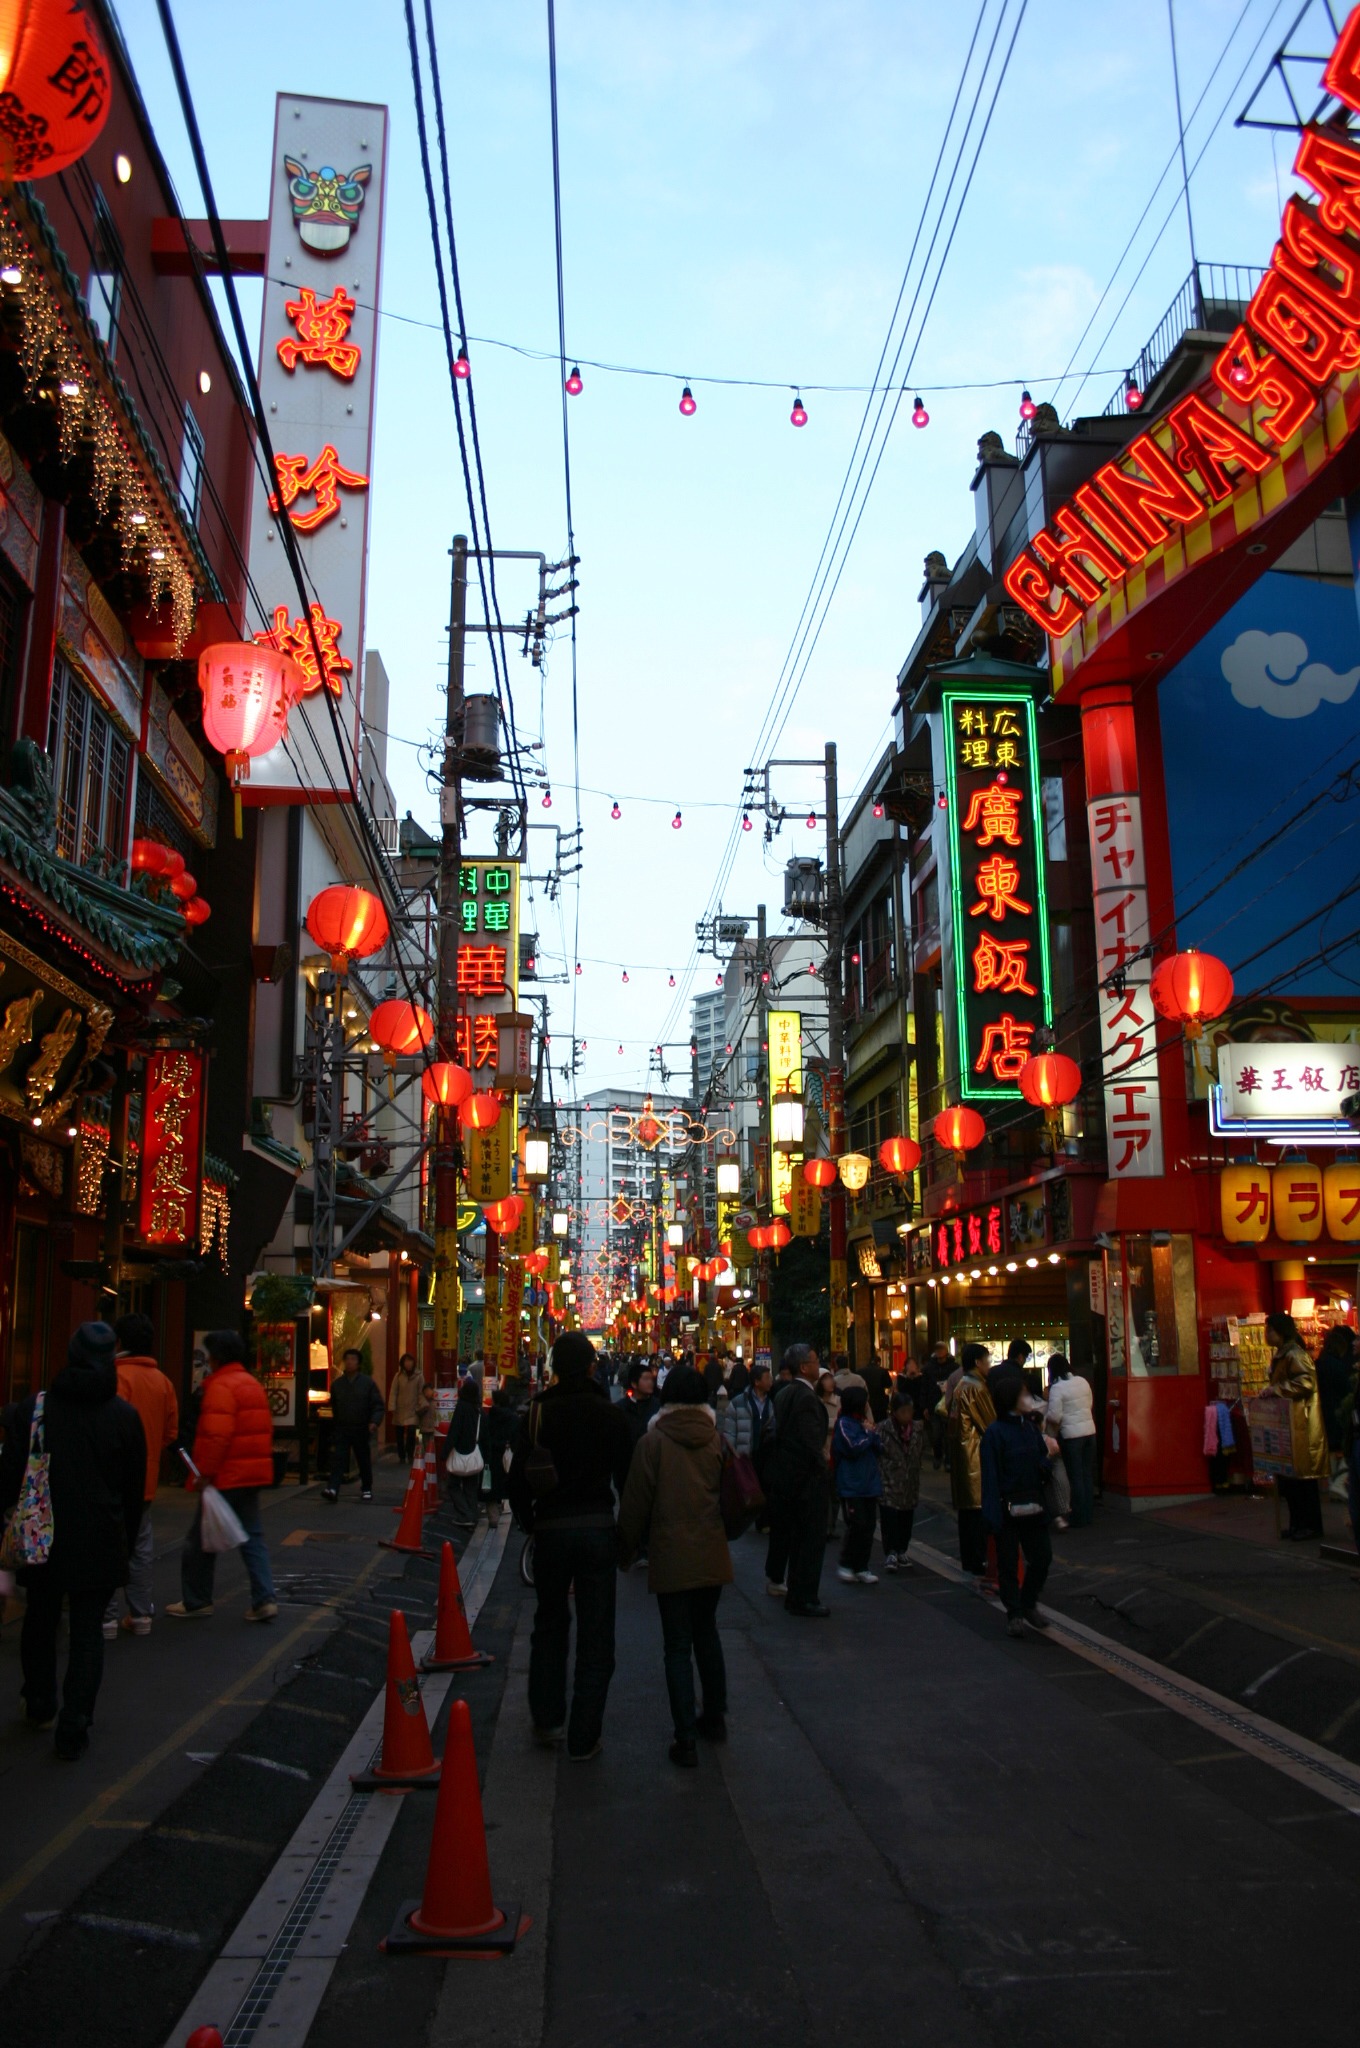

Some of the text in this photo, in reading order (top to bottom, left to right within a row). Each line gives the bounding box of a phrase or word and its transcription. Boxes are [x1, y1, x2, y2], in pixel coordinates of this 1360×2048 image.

[1003, 393, 1273, 639] CHINA
[485, 866, 511, 933] 中華
[962, 785, 1038, 1081] 廣東飯店
[1093, 801, 1152, 1172] チャイナスクエア
[1235, 1064, 1360, 1096] 華王飯店
